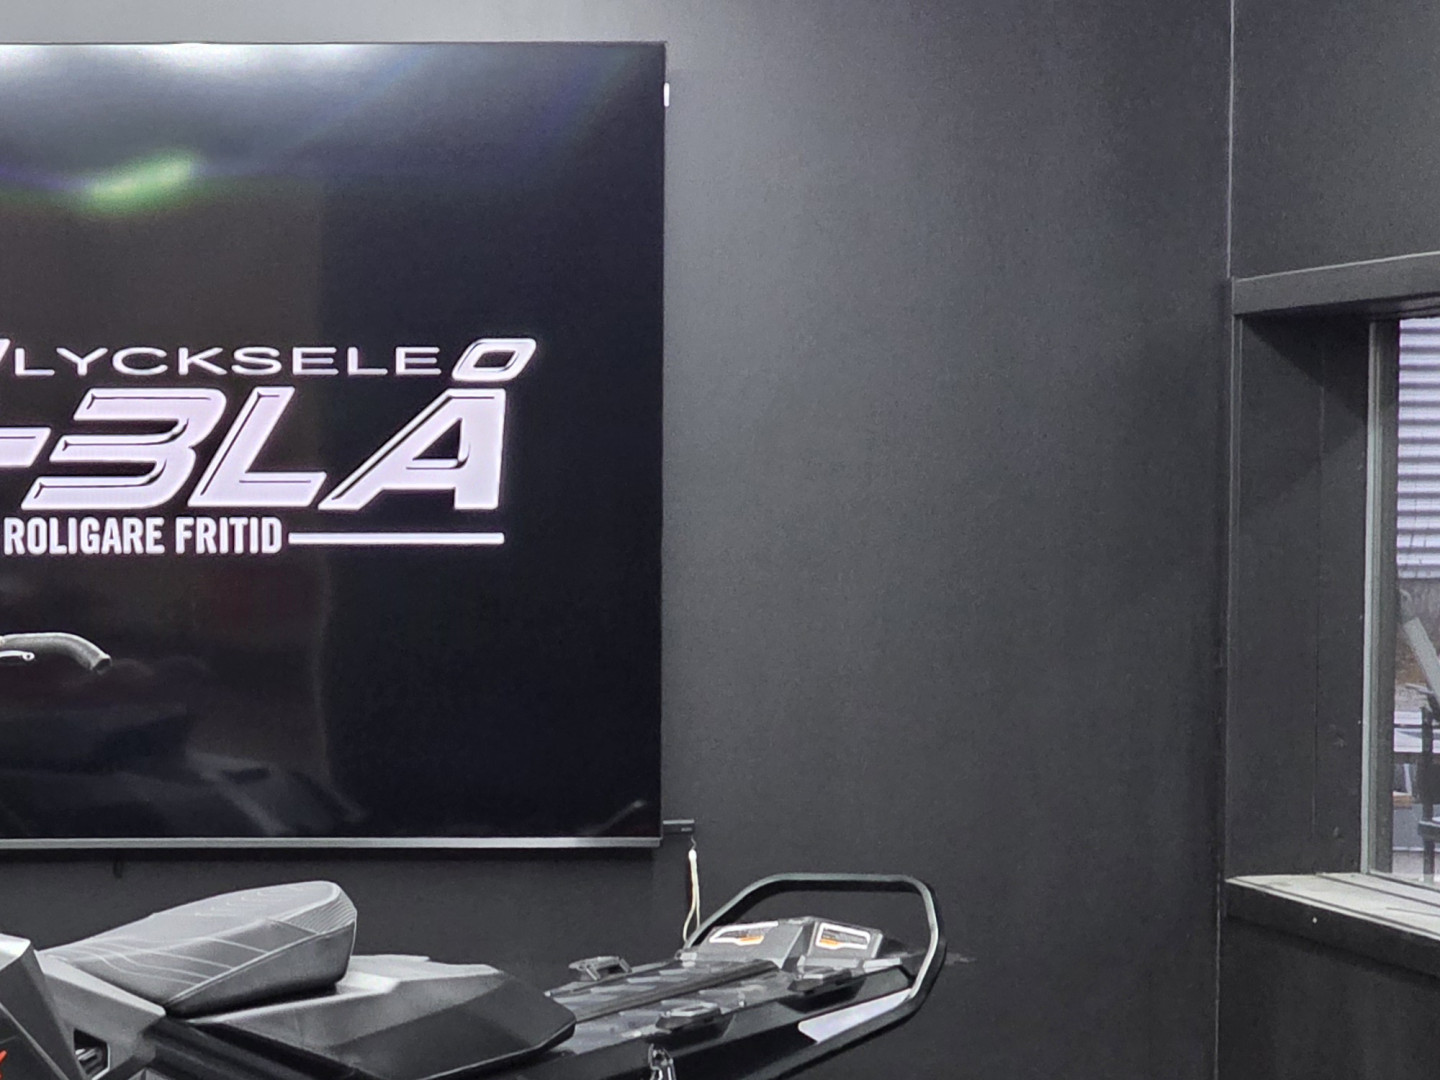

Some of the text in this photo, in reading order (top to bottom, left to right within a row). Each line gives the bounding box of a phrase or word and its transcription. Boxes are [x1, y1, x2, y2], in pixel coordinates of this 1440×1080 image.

[14, 346, 442, 377] LYCKSELE
[3, 516, 165, 555] ROLIGARE
[174, 515, 283, 555] FRITID
